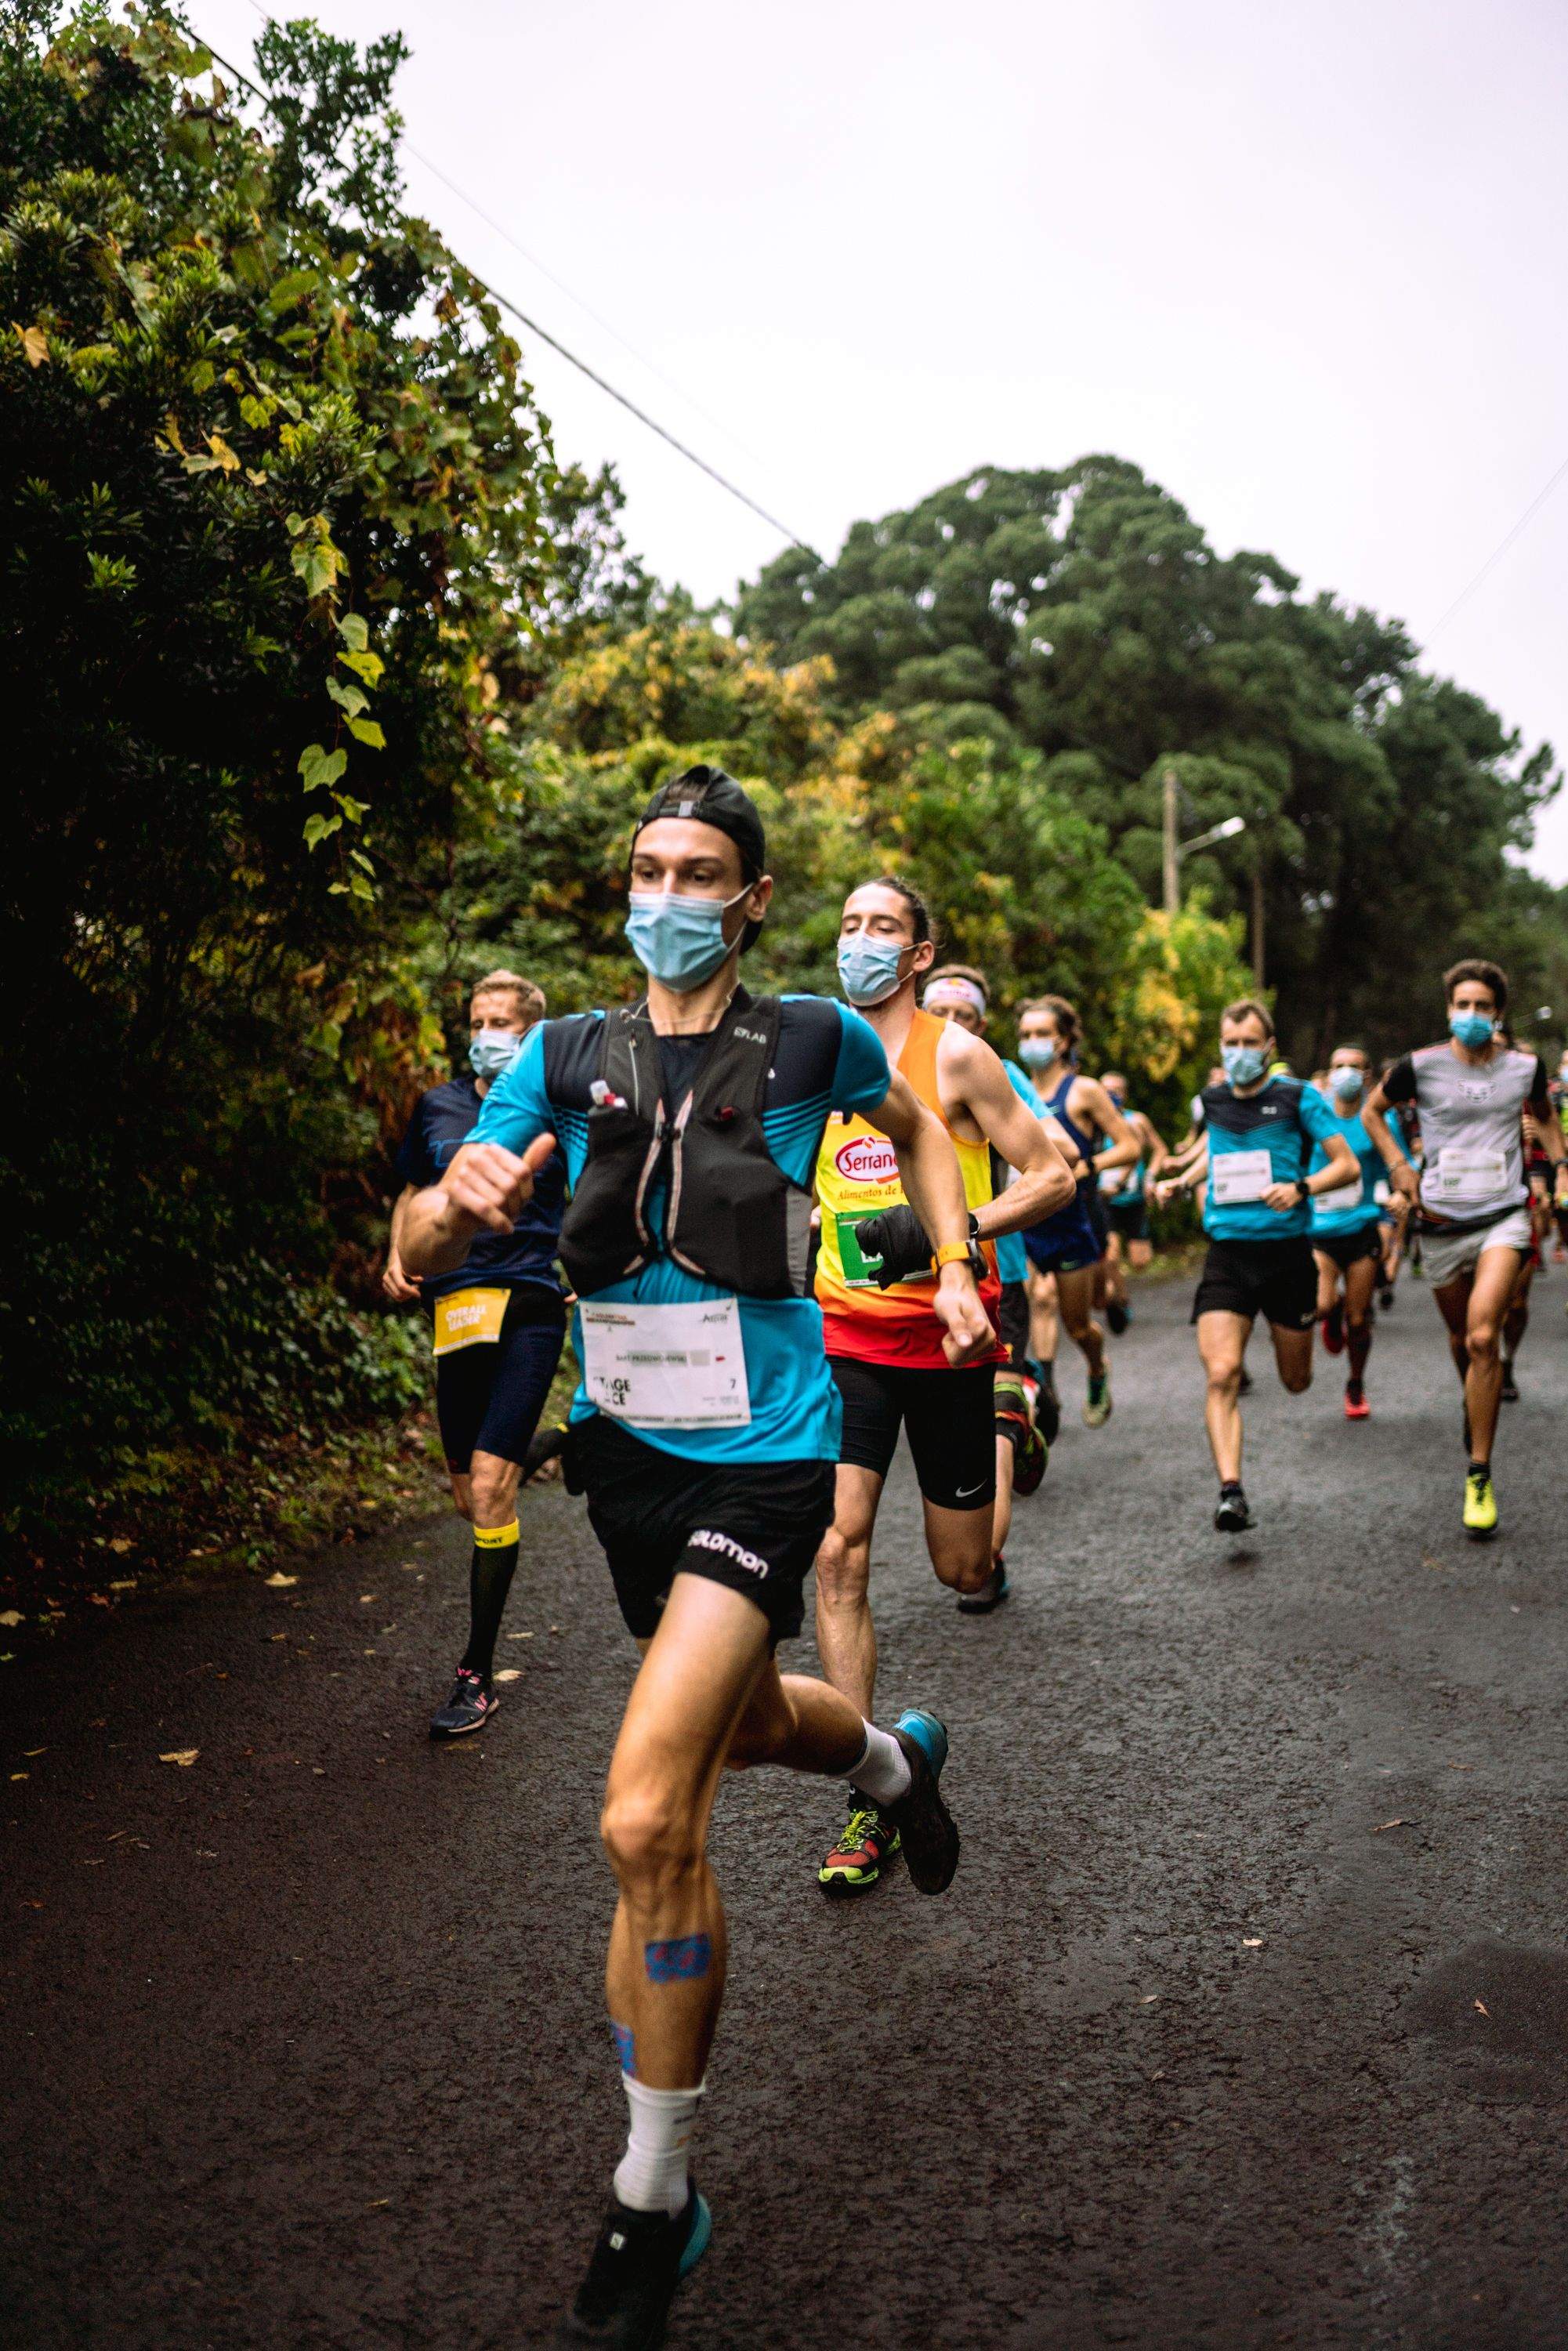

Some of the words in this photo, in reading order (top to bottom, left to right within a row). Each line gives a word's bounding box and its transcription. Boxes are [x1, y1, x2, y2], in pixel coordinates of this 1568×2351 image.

[838, 1188, 882, 1201] Alimentos
[885, 1185, 897, 1196] de
[730, 1378, 737, 1389] 7
